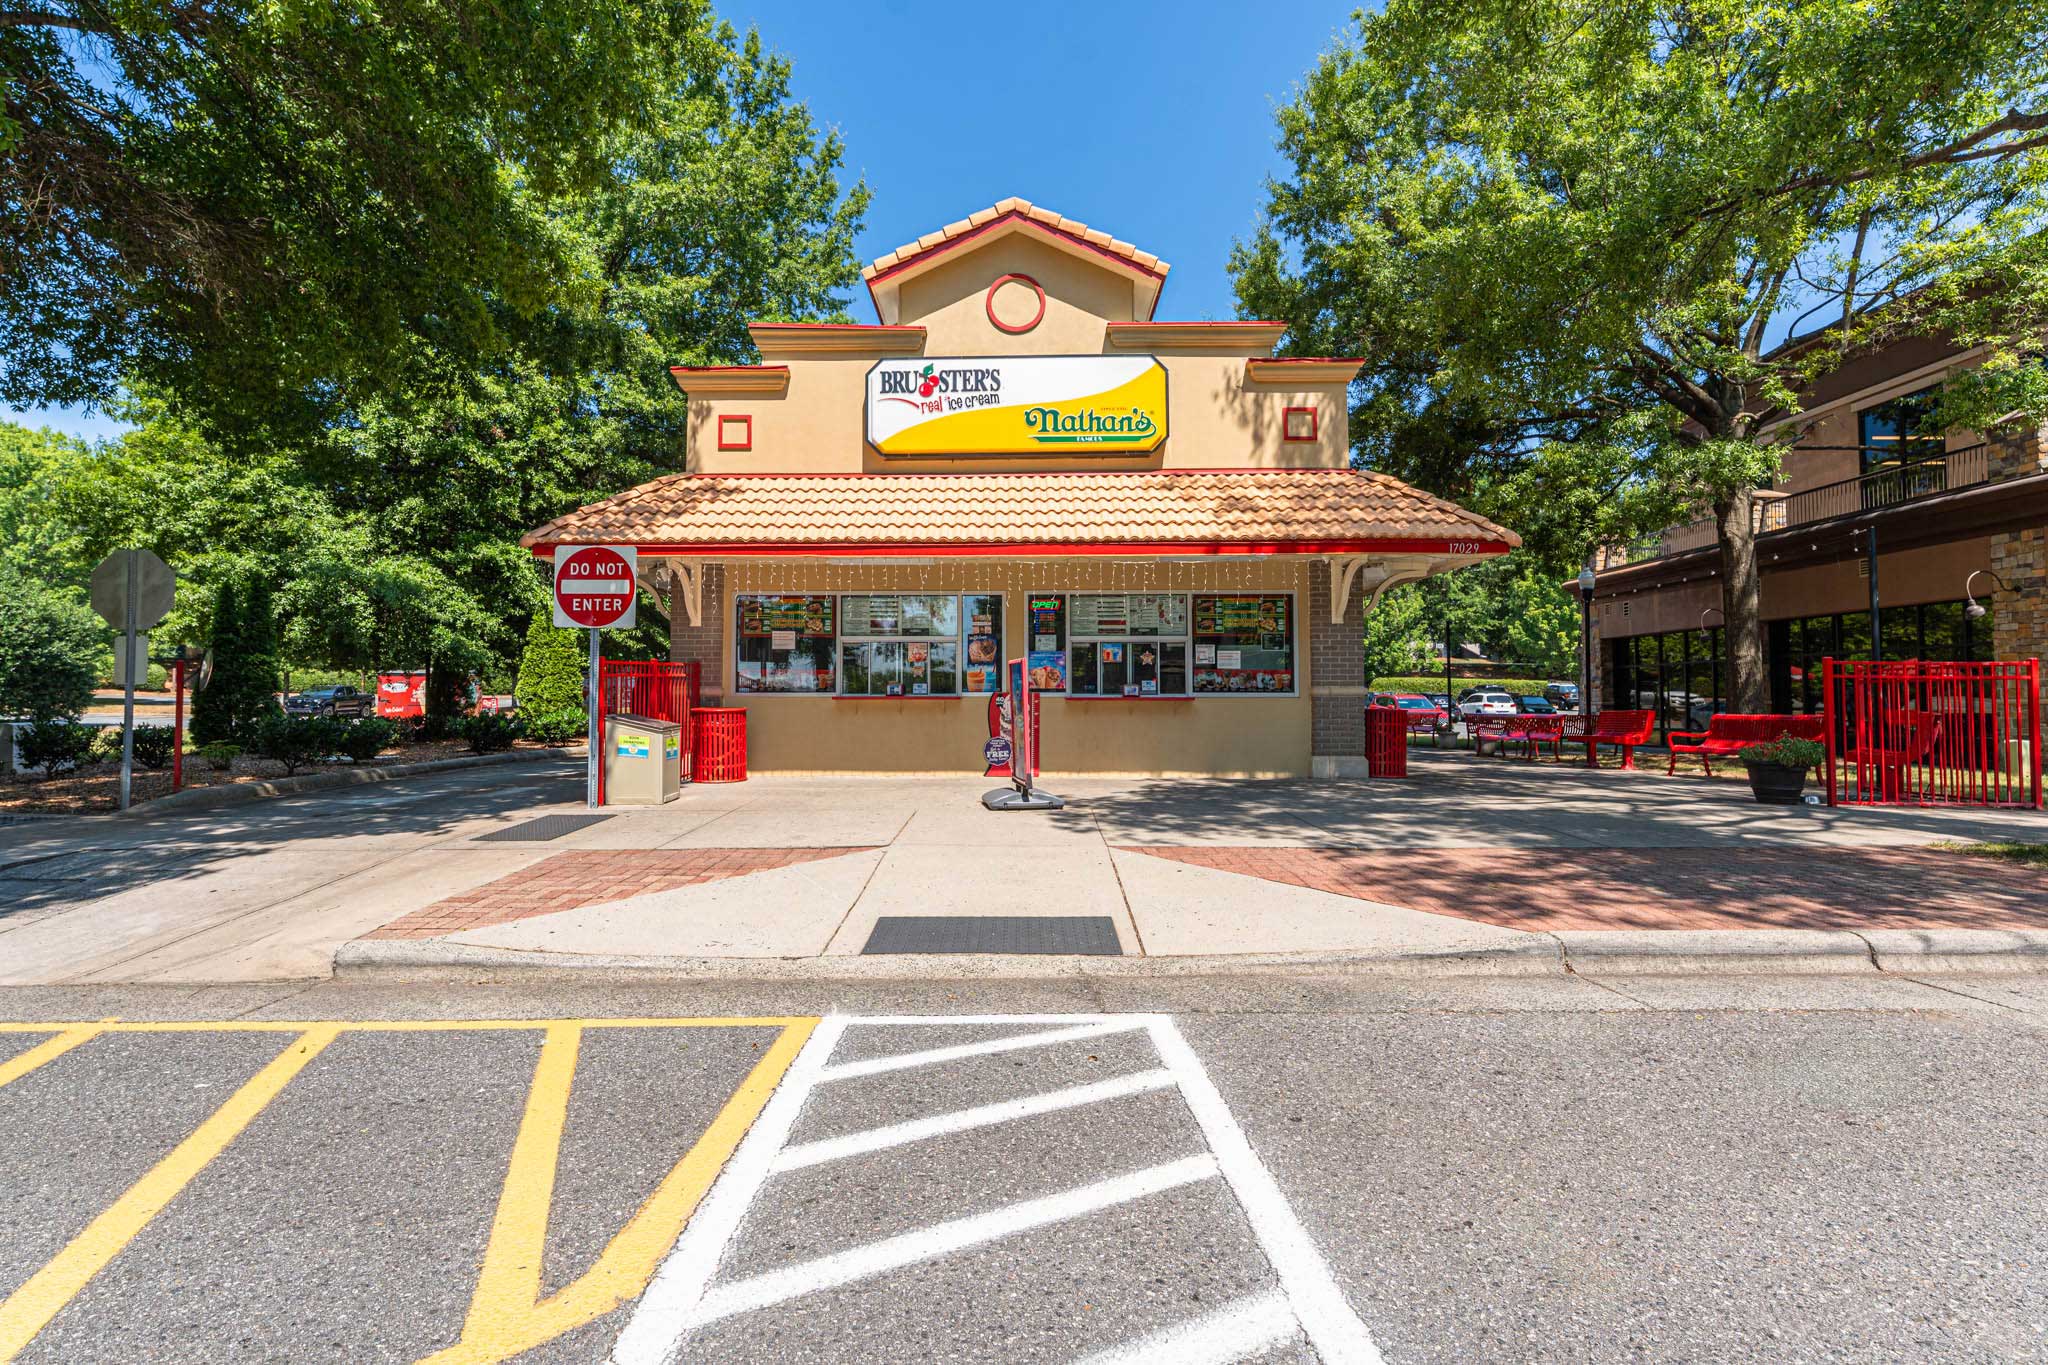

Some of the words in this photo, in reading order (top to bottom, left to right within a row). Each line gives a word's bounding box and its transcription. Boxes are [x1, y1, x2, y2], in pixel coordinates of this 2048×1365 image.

[880, 369, 1001, 395] BRUSTER'S
[920, 396, 943, 415] real
[946, 396, 964, 411] ice
[964, 393, 1001, 409] cream
[1023, 407, 1154, 434] Nathan's
[1449, 543, 1480, 554] 17029
[570, 562, 590, 576] DO
[596, 562, 625, 576] NOT
[573, 598, 623, 612] ENTER
[987, 750, 1009, 758] FREE
